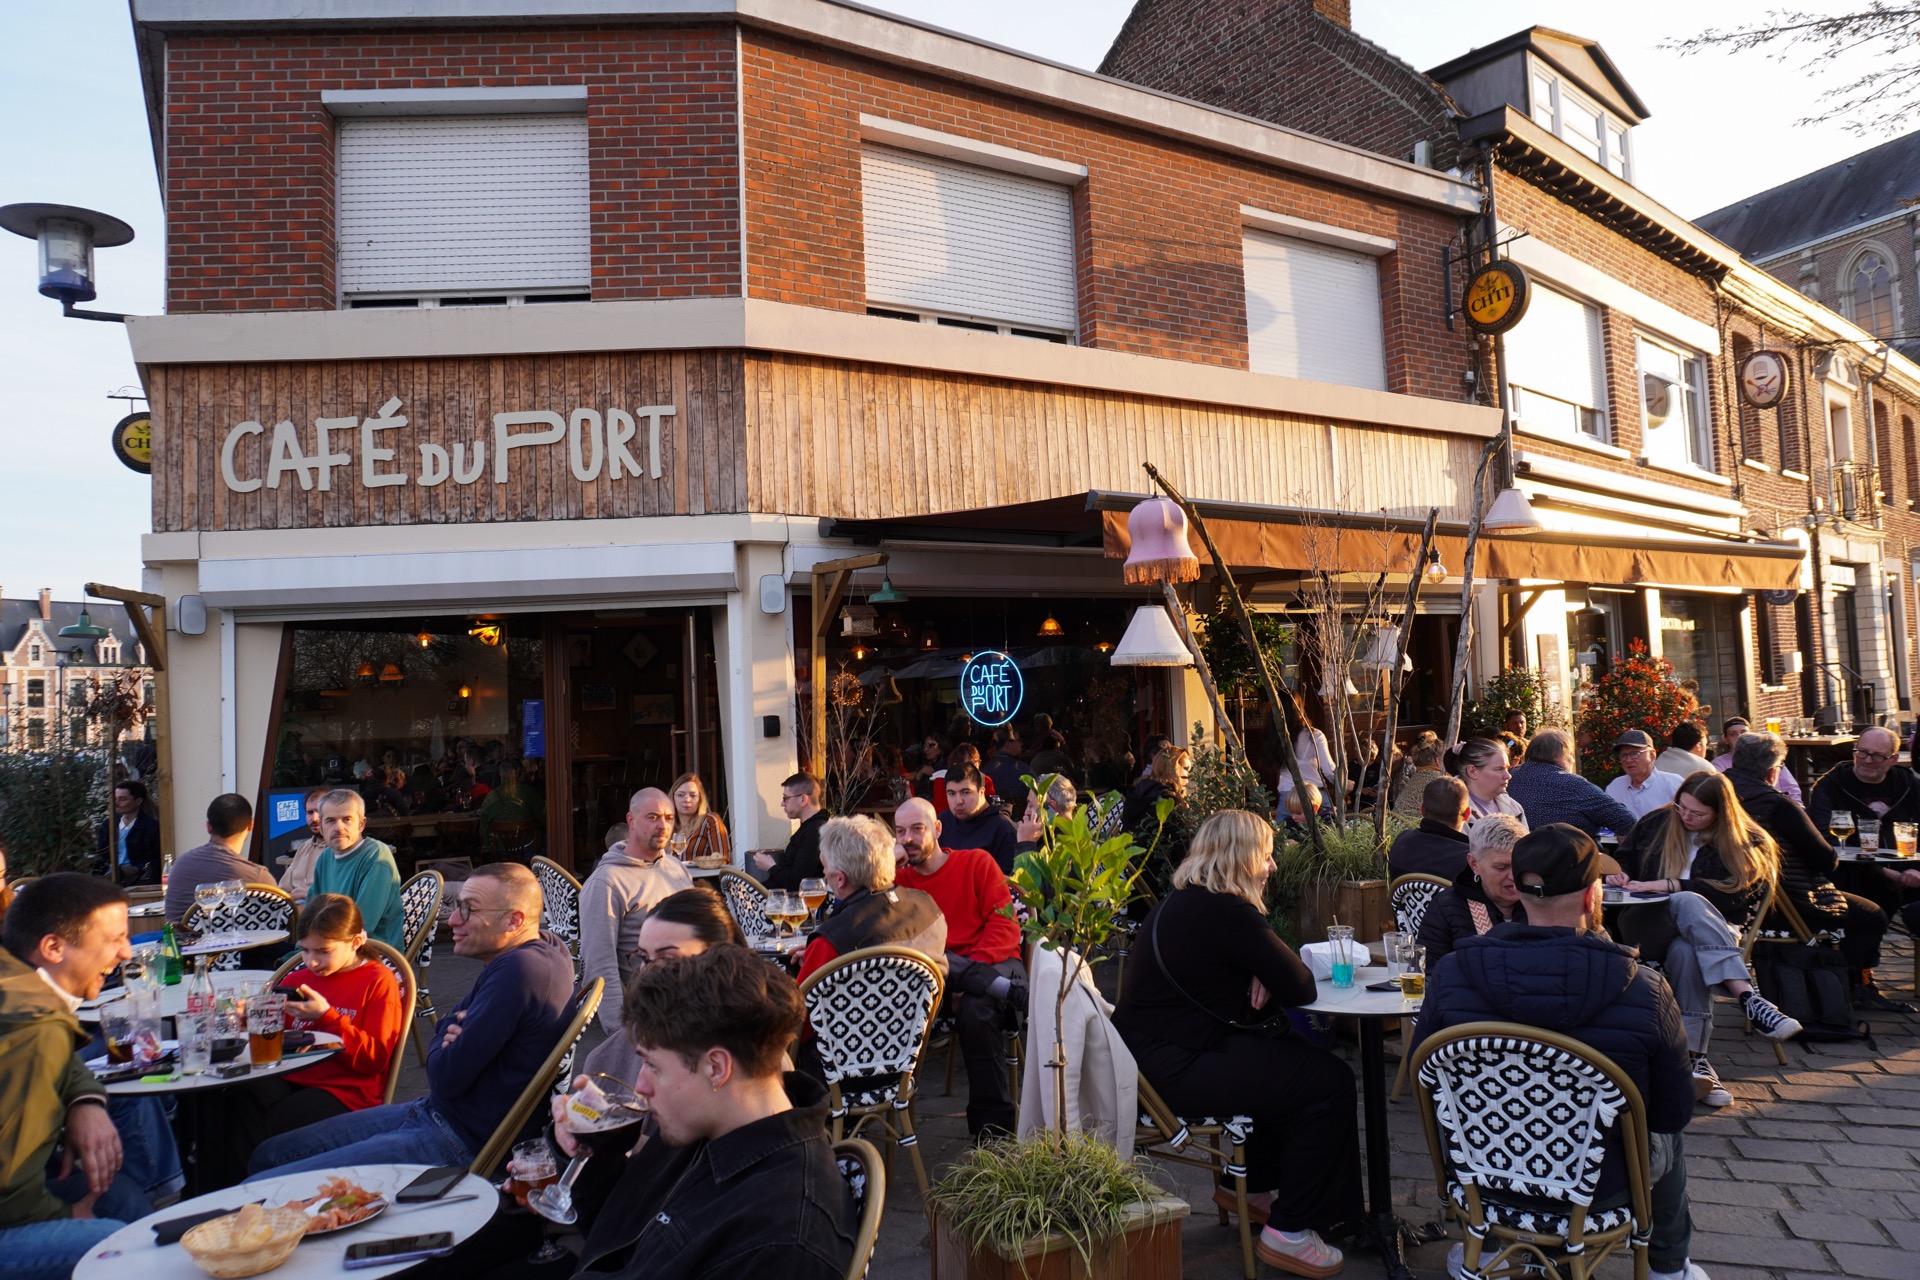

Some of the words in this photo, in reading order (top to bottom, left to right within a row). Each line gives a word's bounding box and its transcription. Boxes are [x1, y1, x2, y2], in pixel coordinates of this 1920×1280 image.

[1471, 286, 1510, 313] CH'TI
[221, 396, 408, 493] CAFÉ
[417, 441, 485, 487] DU
[493, 405, 677, 485] PORT
[970, 660, 1011, 685] CAFÉ
[971, 685, 985, 697] DU
[972, 684, 1013, 714] PORT
